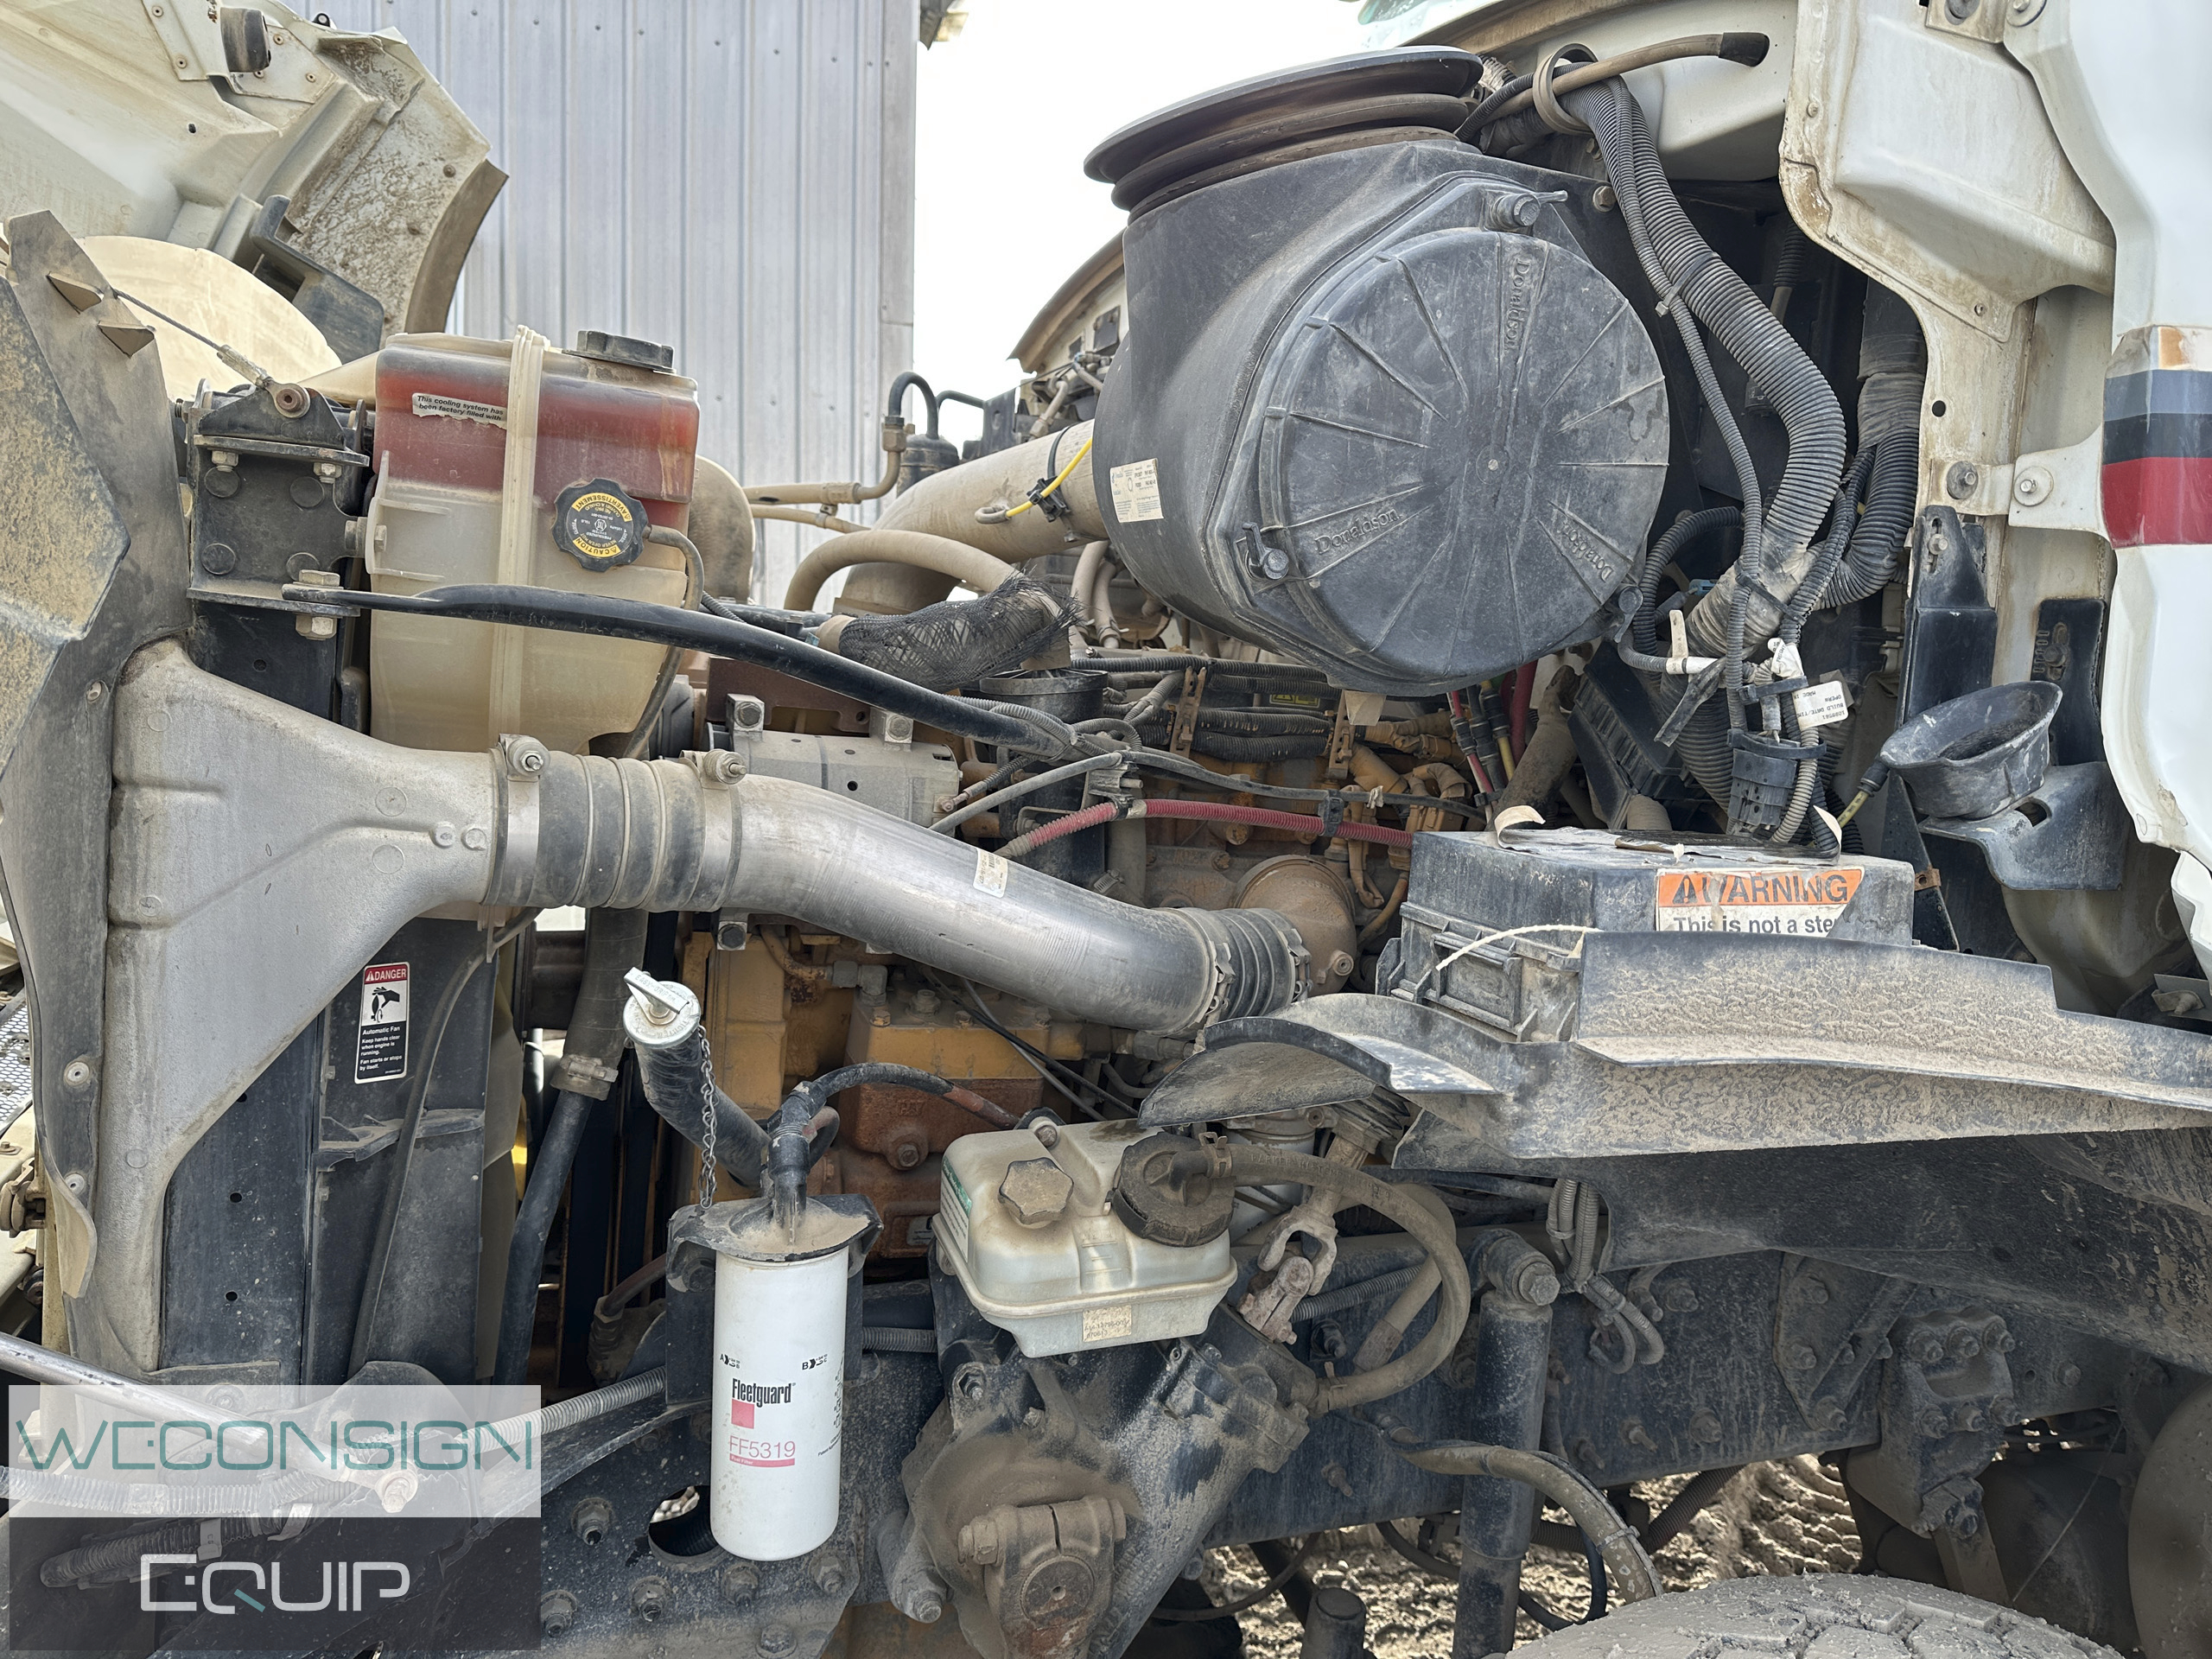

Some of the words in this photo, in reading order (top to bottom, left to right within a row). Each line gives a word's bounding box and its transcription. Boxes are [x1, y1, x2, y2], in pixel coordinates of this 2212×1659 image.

[434, 397, 461, 408] cooling
[463, 403, 488, 412] system
[490, 407, 504, 416] has
[439, 405, 465, 416] factory
[575, 494, 627, 516] AVERTISSEMENT
[1314, 509, 1399, 555] Donaldson
[575, 538, 610, 555] CAUTION
[1827, 702, 1844, 711] BUILD
[1722, 915, 1742, 932] is
[1749, 916, 1782, 934] not
[1787, 918, 1799, 933] a
[374, 969, 407, 981] DANGER
[732, 1378, 791, 1408] Fleetguard
[730, 1435, 796, 1459] FF5319
[741, 1457, 753, 1465] Filter
